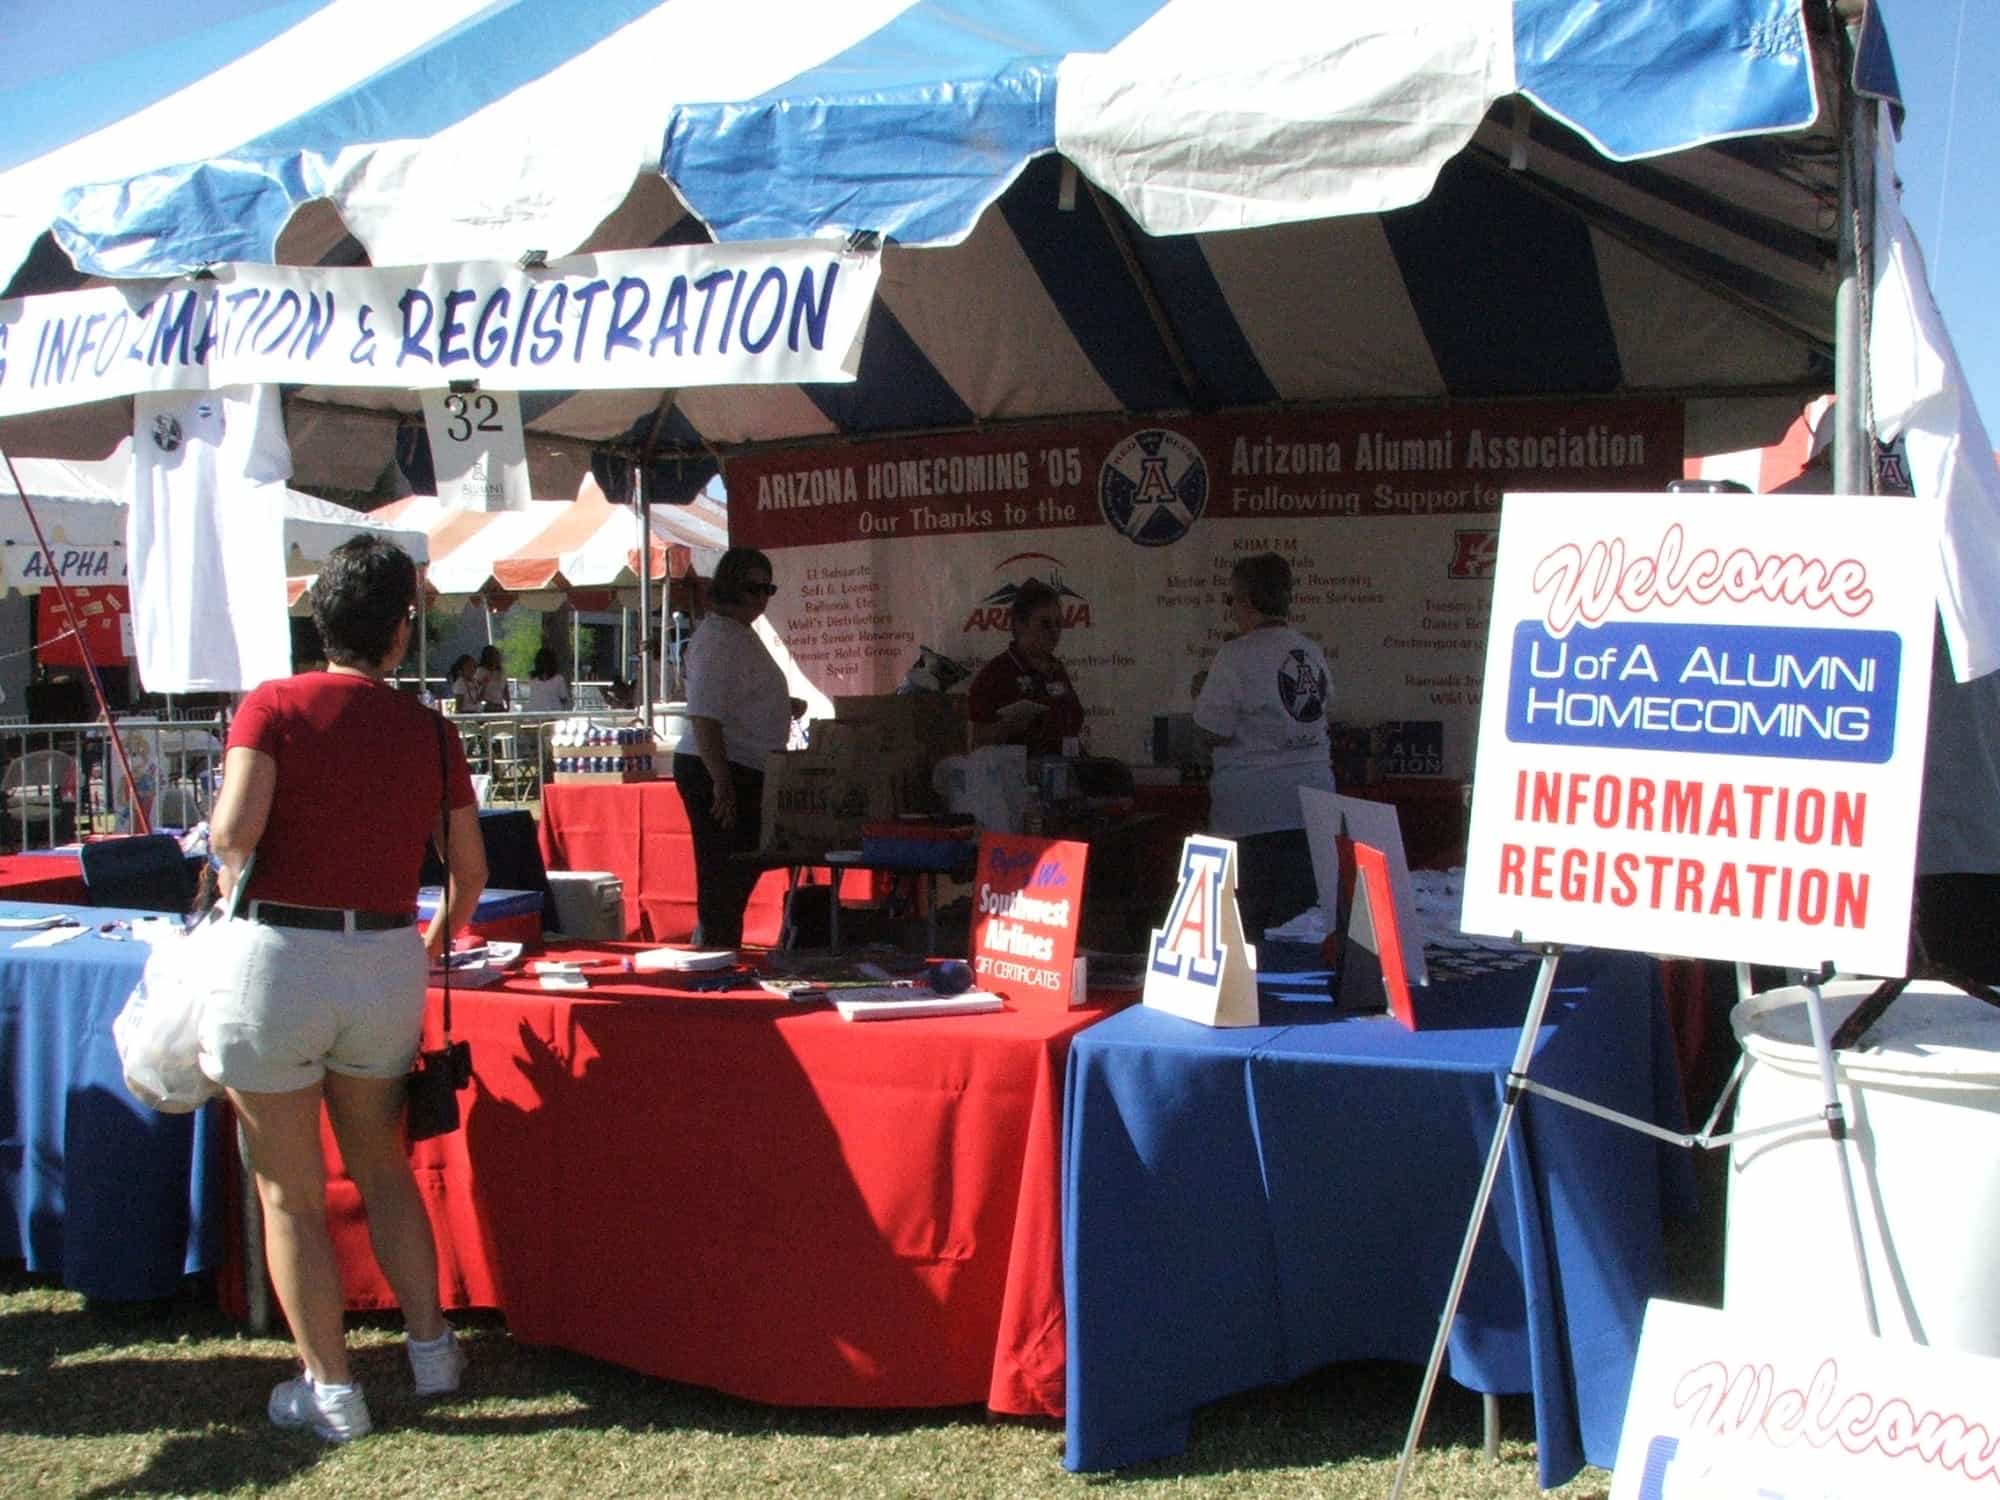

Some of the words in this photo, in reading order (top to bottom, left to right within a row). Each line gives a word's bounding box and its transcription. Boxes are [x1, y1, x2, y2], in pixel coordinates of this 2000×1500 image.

[350, 303, 378, 367] &
[394, 260, 839, 368] REGISTRATION
[444, 394, 504, 442] 32
[1231, 434, 1342, 476] Arizona
[1354, 430, 1454, 473] Alumni
[1466, 425, 1647, 471] Association
[757, 466, 857, 512] ARIZONA
[866, 450, 1030, 501] HOMECOMING
[1039, 447, 1083, 488] '05
[1133, 456, 1176, 504] A
[1231, 486, 1361, 516] Following
[858, 510, 899, 534] Our
[909, 503, 994, 530] Thanks
[1004, 503, 1028, 526] to
[1038, 498, 1077, 523] the
[22, 550, 110, 577] ALPHA
[1532, 523, 1874, 633] Welcome
[1679, 646, 1877, 692] ALUMNI
[1526, 690, 1870, 742] HOMECOMING
[1514, 769, 1867, 849] INFORMATION
[979, 882, 1070, 928] Southwest
[1497, 843, 1870, 930] REGISTRATION
[984, 918, 1054, 960] Airlines
[1152, 844, 1227, 987] A
[994, 960, 1062, 991] CERTIFICATES
